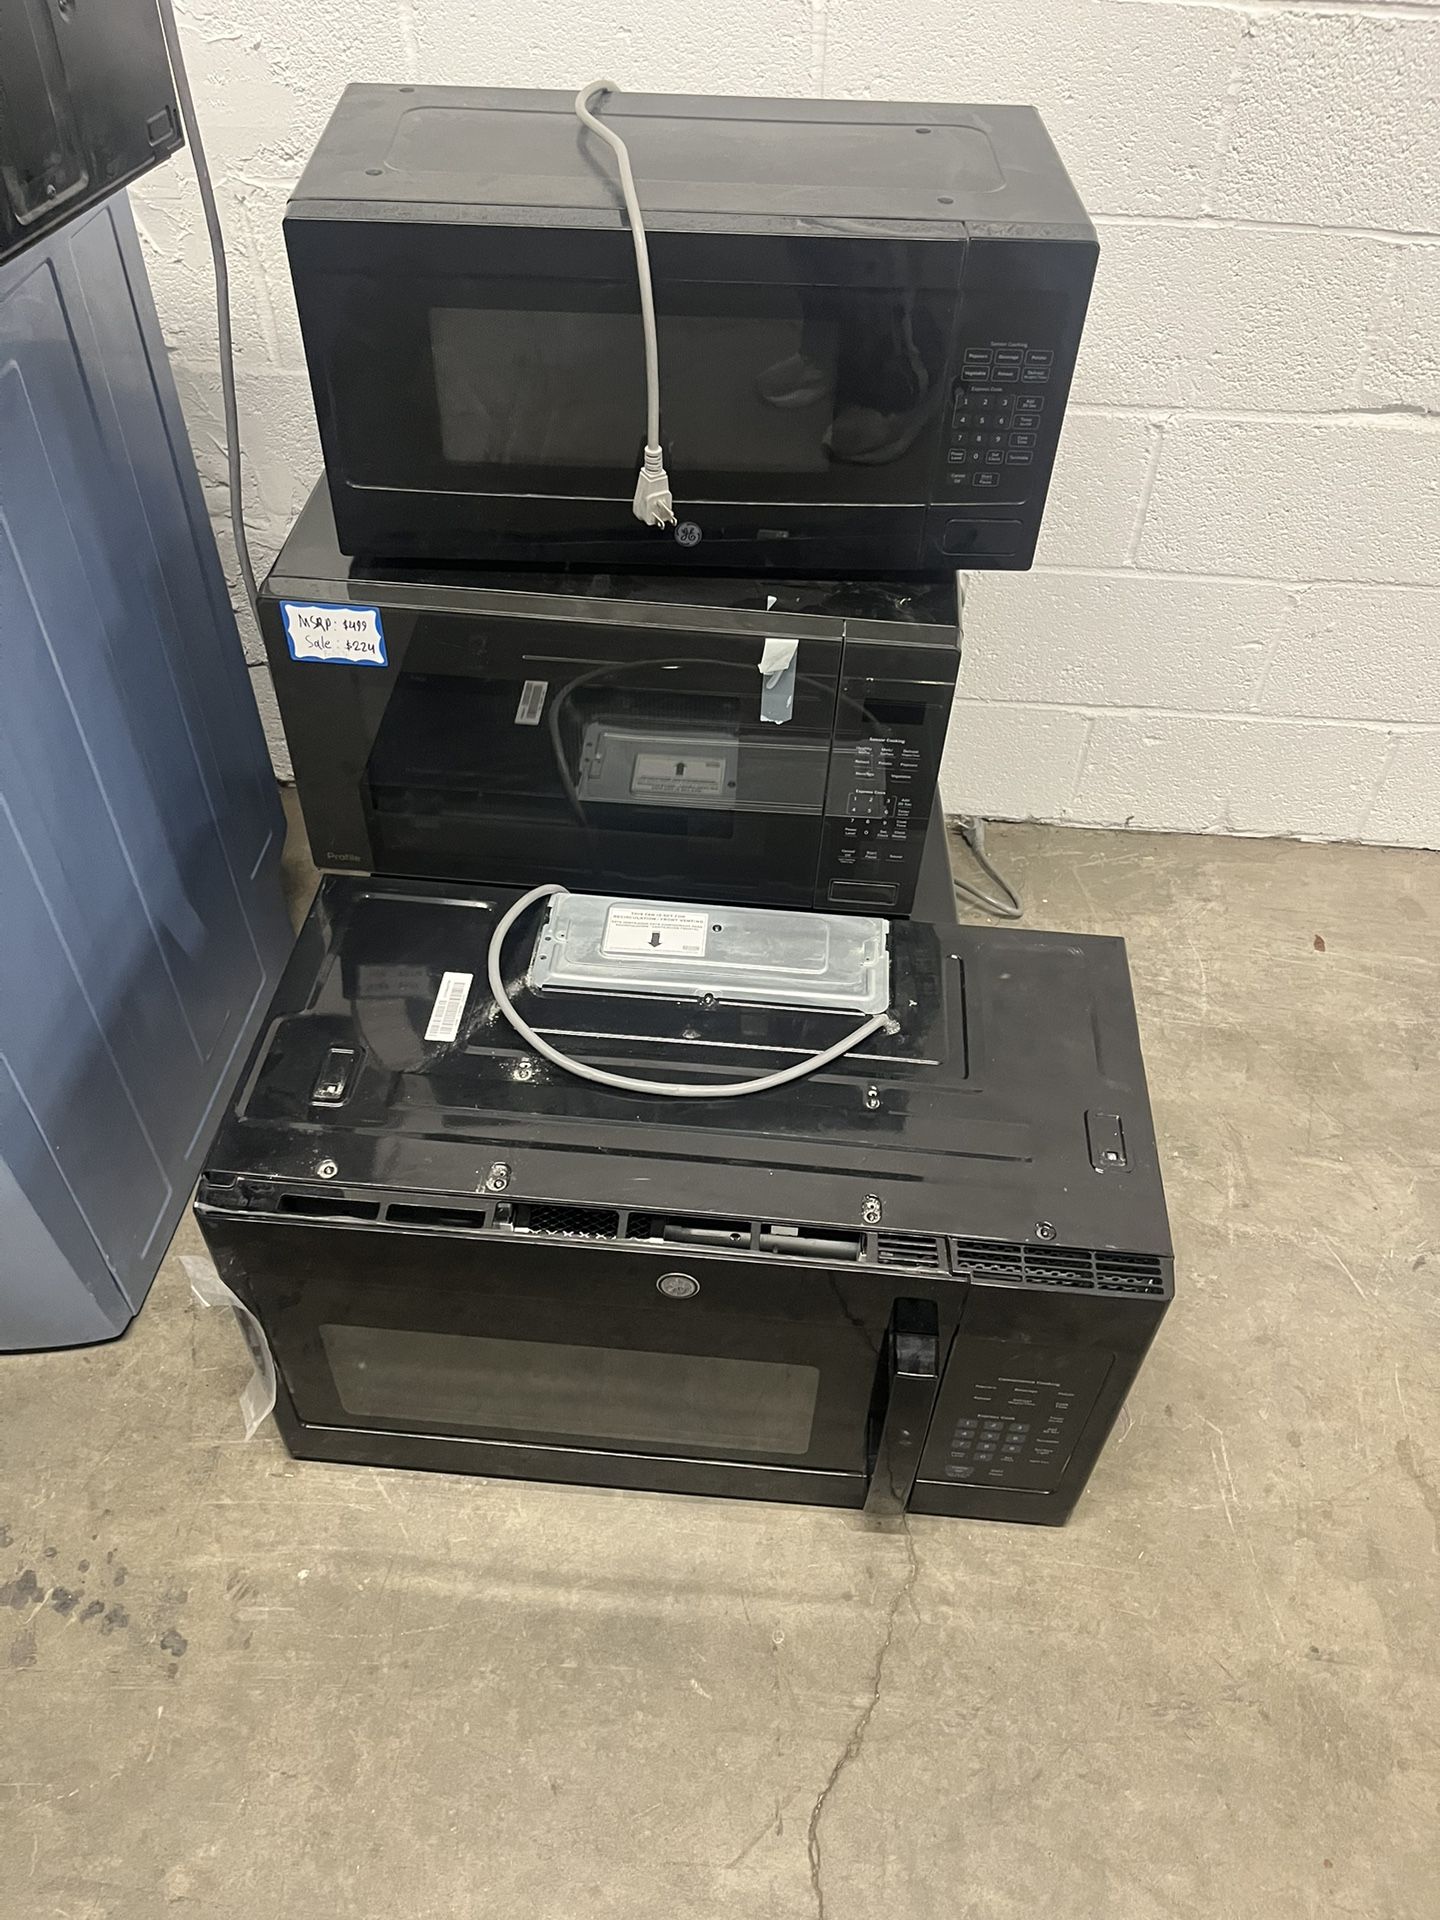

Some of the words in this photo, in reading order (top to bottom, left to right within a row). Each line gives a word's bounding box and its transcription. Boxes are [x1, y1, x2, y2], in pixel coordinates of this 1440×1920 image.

[343, 619, 367, 632] $499
[346, 640, 376, 654] $224
[327, 852, 361, 862] Profile
